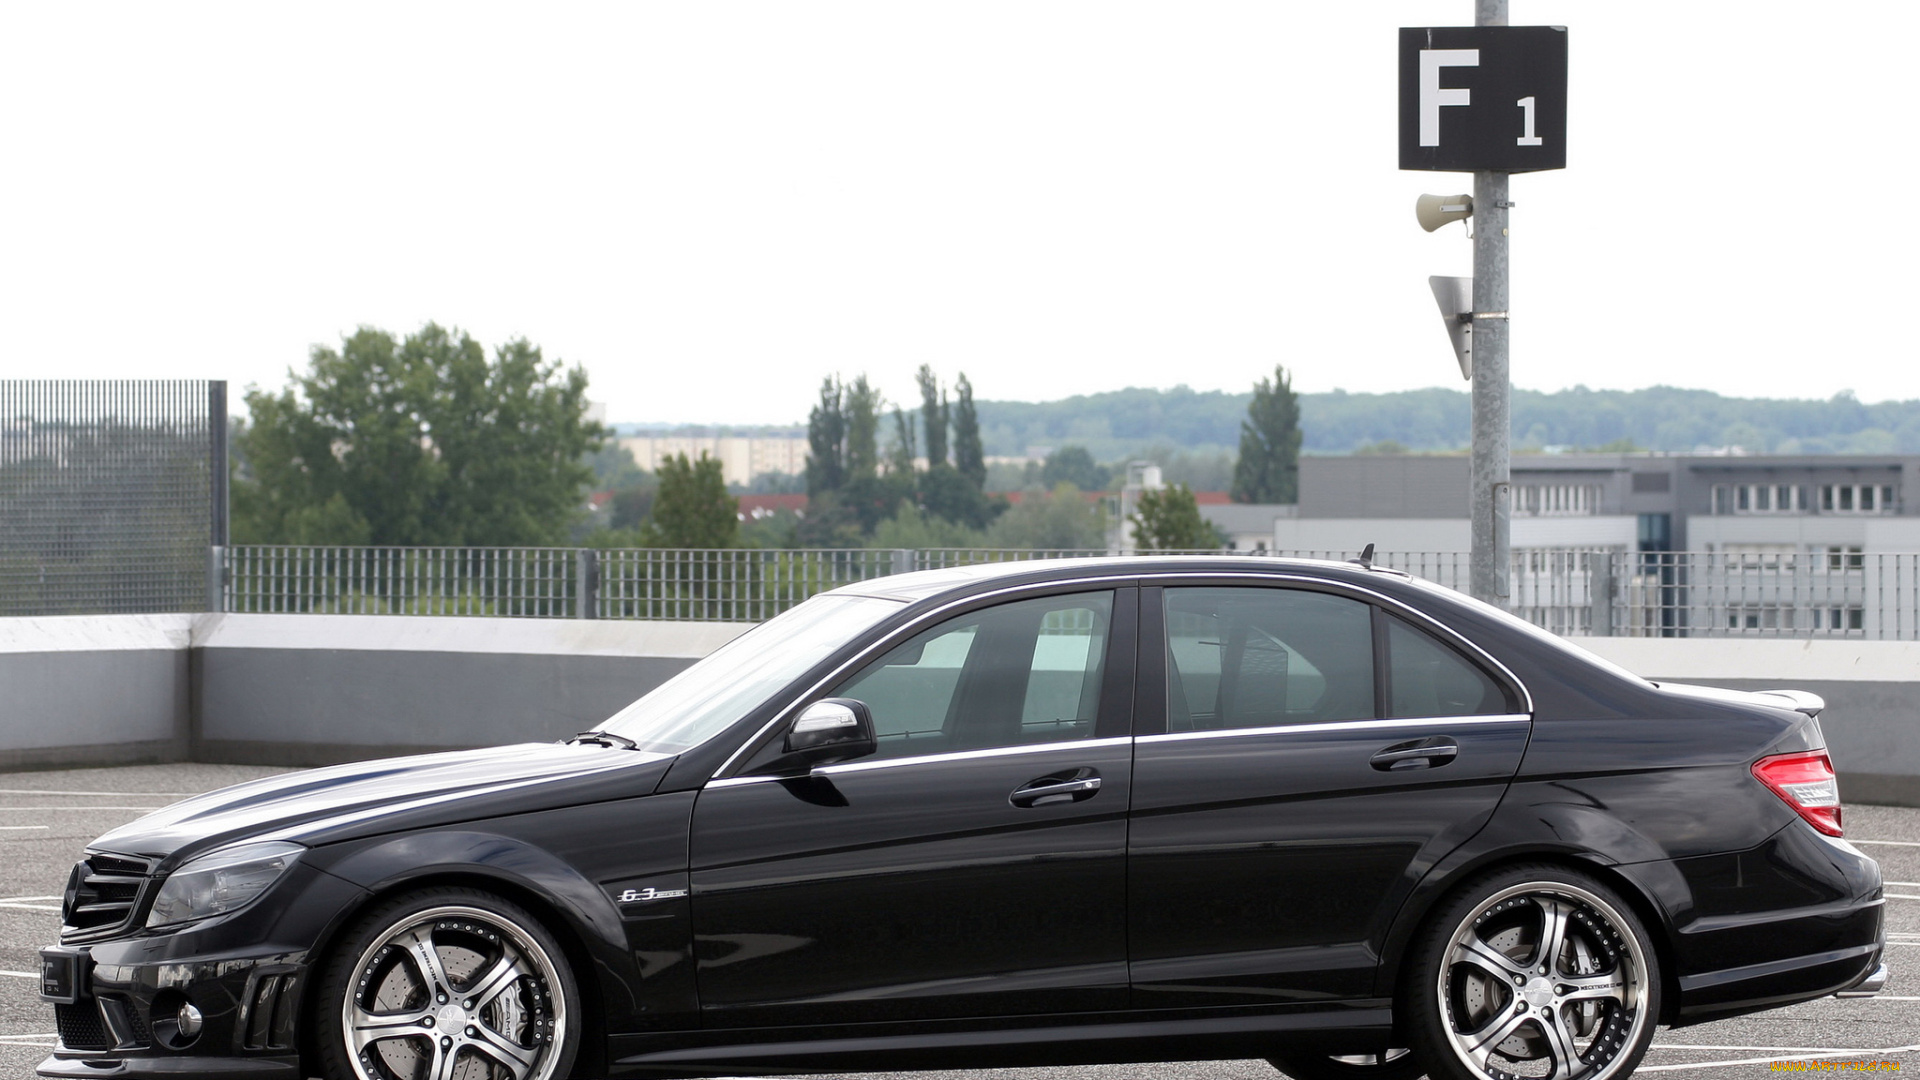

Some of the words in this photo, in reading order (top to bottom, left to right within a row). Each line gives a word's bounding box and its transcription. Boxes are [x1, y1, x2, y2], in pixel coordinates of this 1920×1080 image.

[1419, 49, 1480, 147] F
[1516, 96, 1543, 146] 1
[621, 887, 655, 902] 6.3
